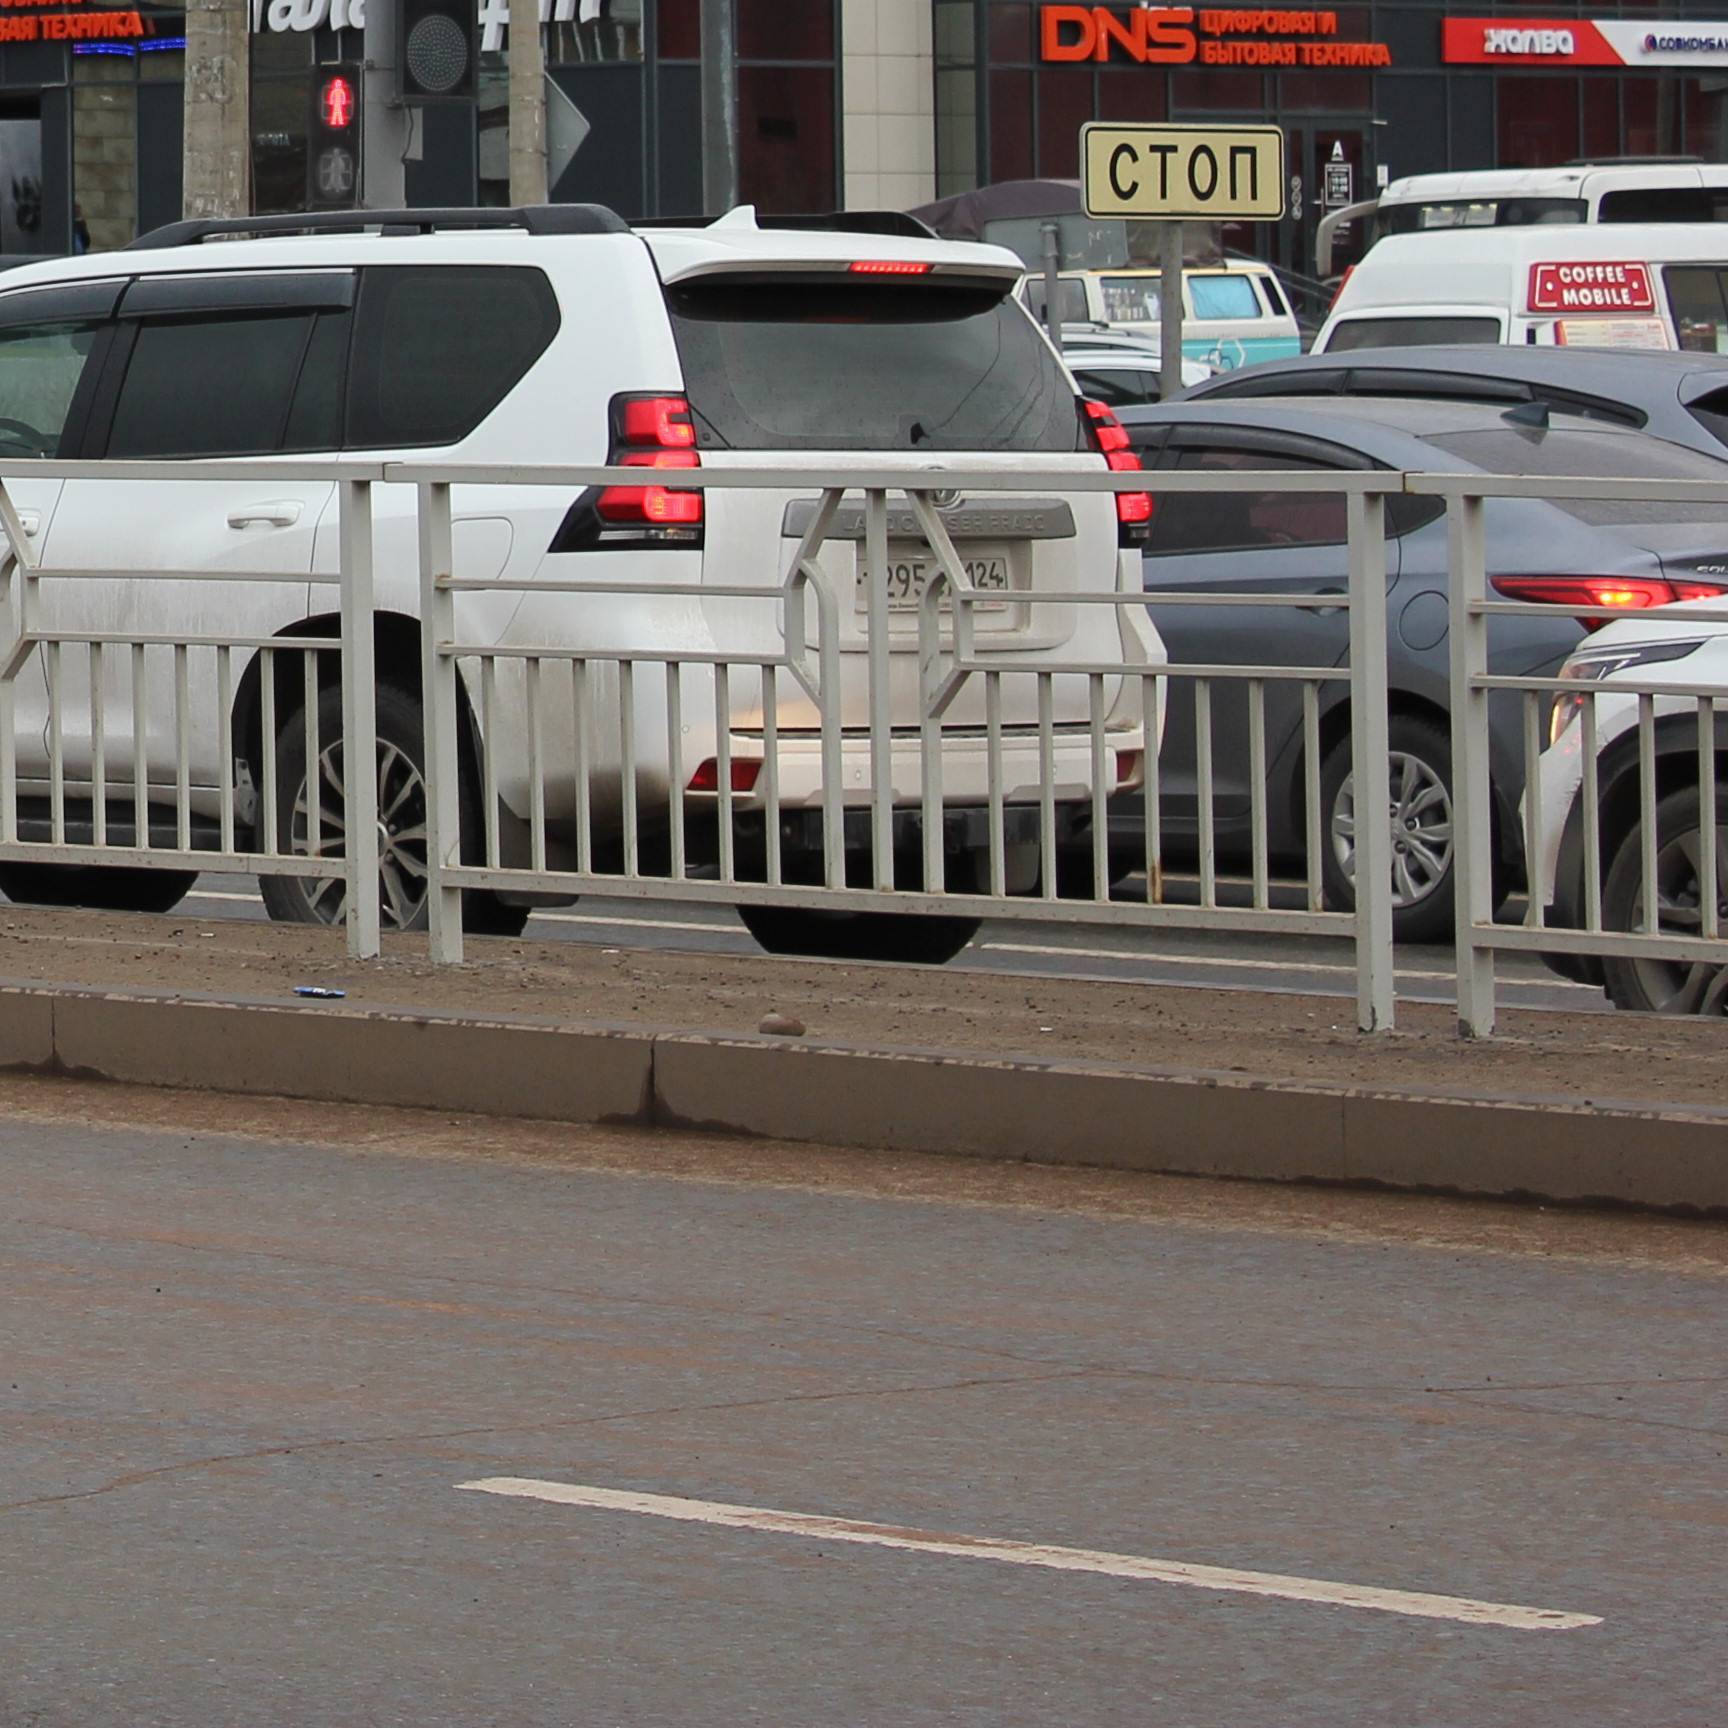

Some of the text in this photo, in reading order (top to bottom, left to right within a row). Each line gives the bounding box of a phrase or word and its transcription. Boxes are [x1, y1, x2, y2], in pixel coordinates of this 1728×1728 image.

[40, 11, 146, 40] ТЕХНИКА
[1041, 6, 1197, 64] DNS
[1199, 10, 1337, 36] ЦИФРОВАЯ И
[1201, 42, 1392, 66] БЫТОВАЯ ТЕХНИКА
[1108, 144, 1258, 201] СТОП
[1559, 265, 1626, 284] COFFEE
[1562, 288, 1632, 306] MOBILE
